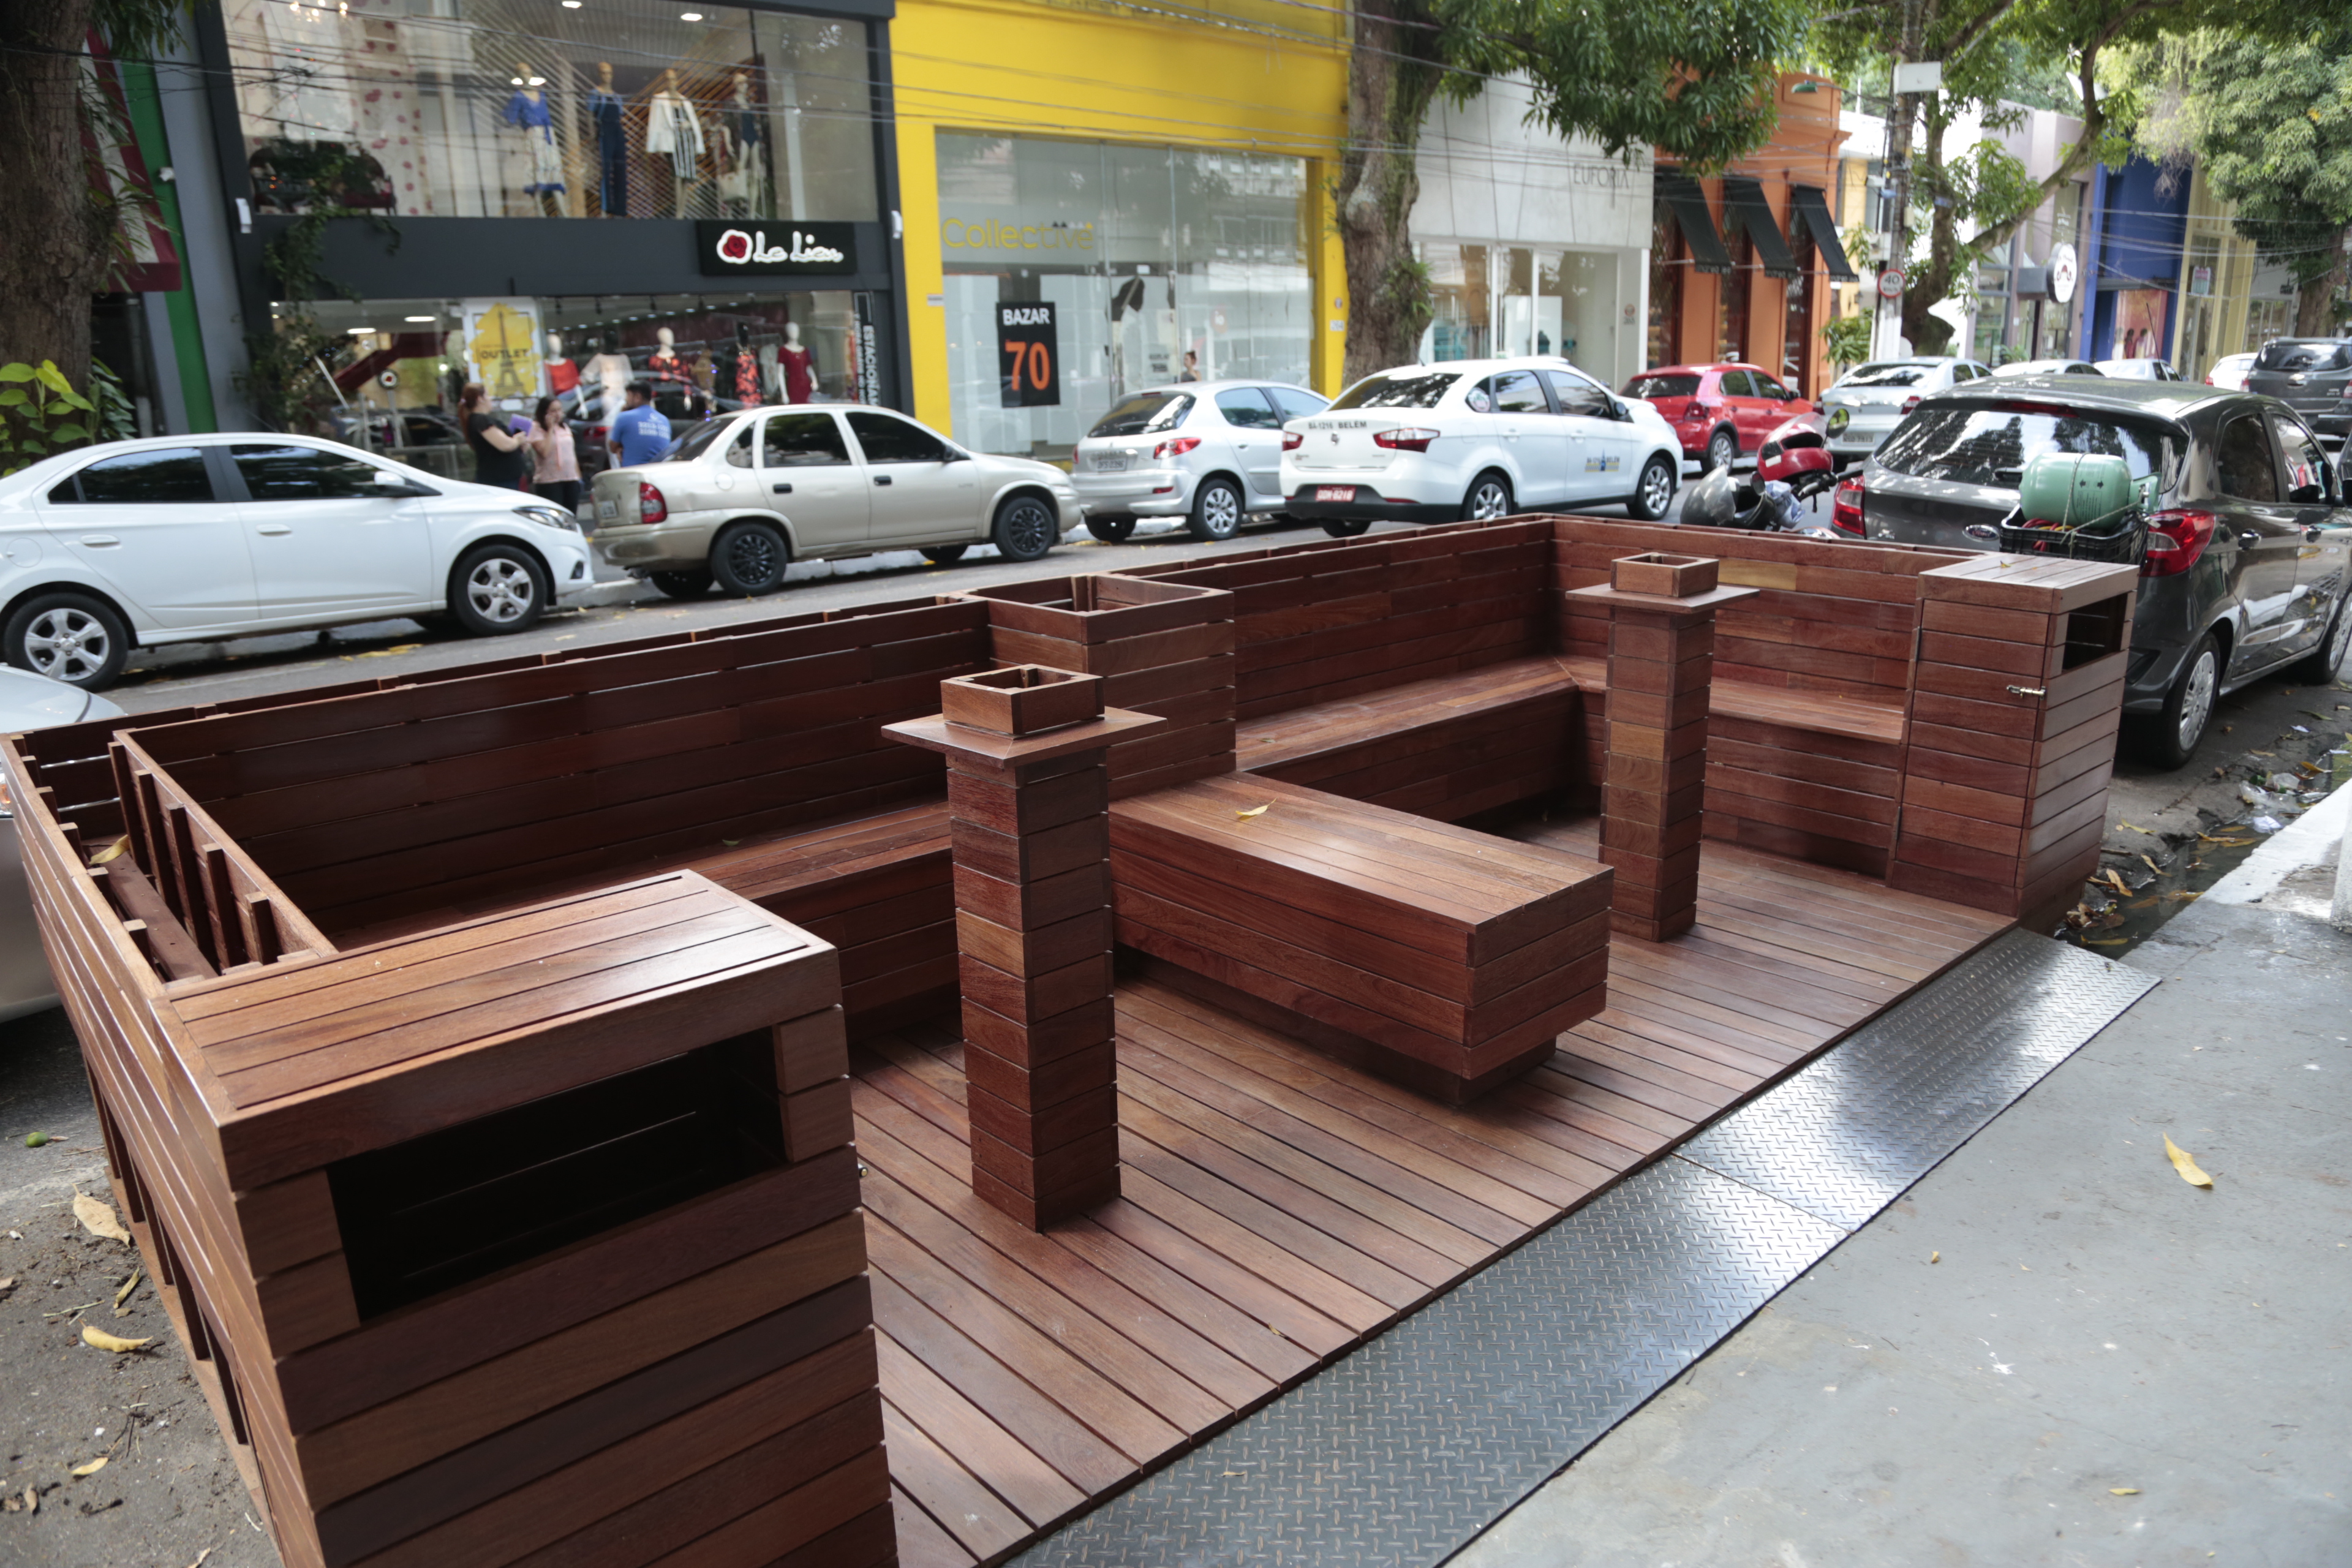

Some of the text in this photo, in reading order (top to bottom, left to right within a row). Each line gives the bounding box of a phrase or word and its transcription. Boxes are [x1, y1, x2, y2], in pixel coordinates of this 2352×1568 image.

[941, 218, 1094, 249] Collective
[753, 231, 788, 263] Le
[1884, 274, 1900, 285] 40
[1003, 307, 1050, 325] BAZAR
[480, 348, 529, 360] OUTLET
[1005, 341, 1050, 391] 70
